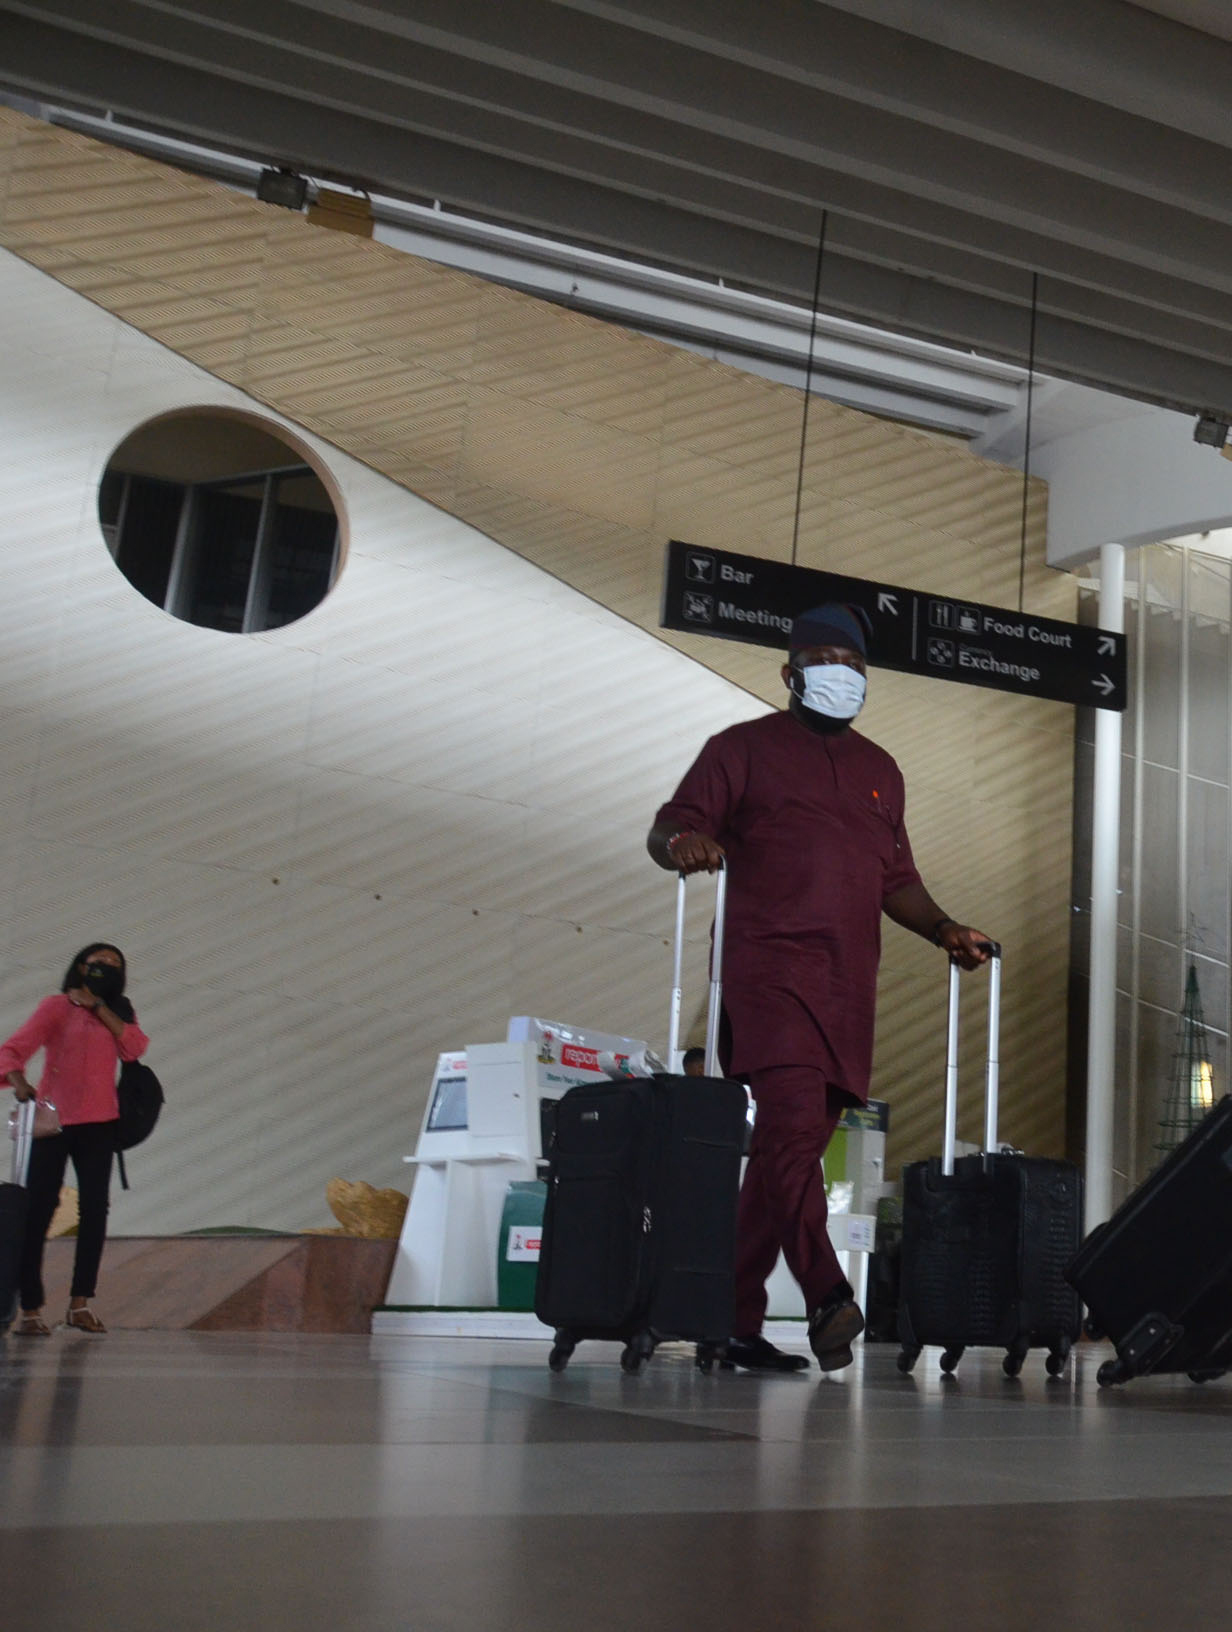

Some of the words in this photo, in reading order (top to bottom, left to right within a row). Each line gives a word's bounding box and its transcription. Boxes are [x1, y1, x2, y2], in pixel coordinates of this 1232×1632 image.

[720, 564, 754, 585] Bar
[718, 601, 794, 634] Meeting
[983, 616, 1025, 639] Food
[1028, 626, 1073, 649] Court
[958, 651, 1041, 682] Exchange
